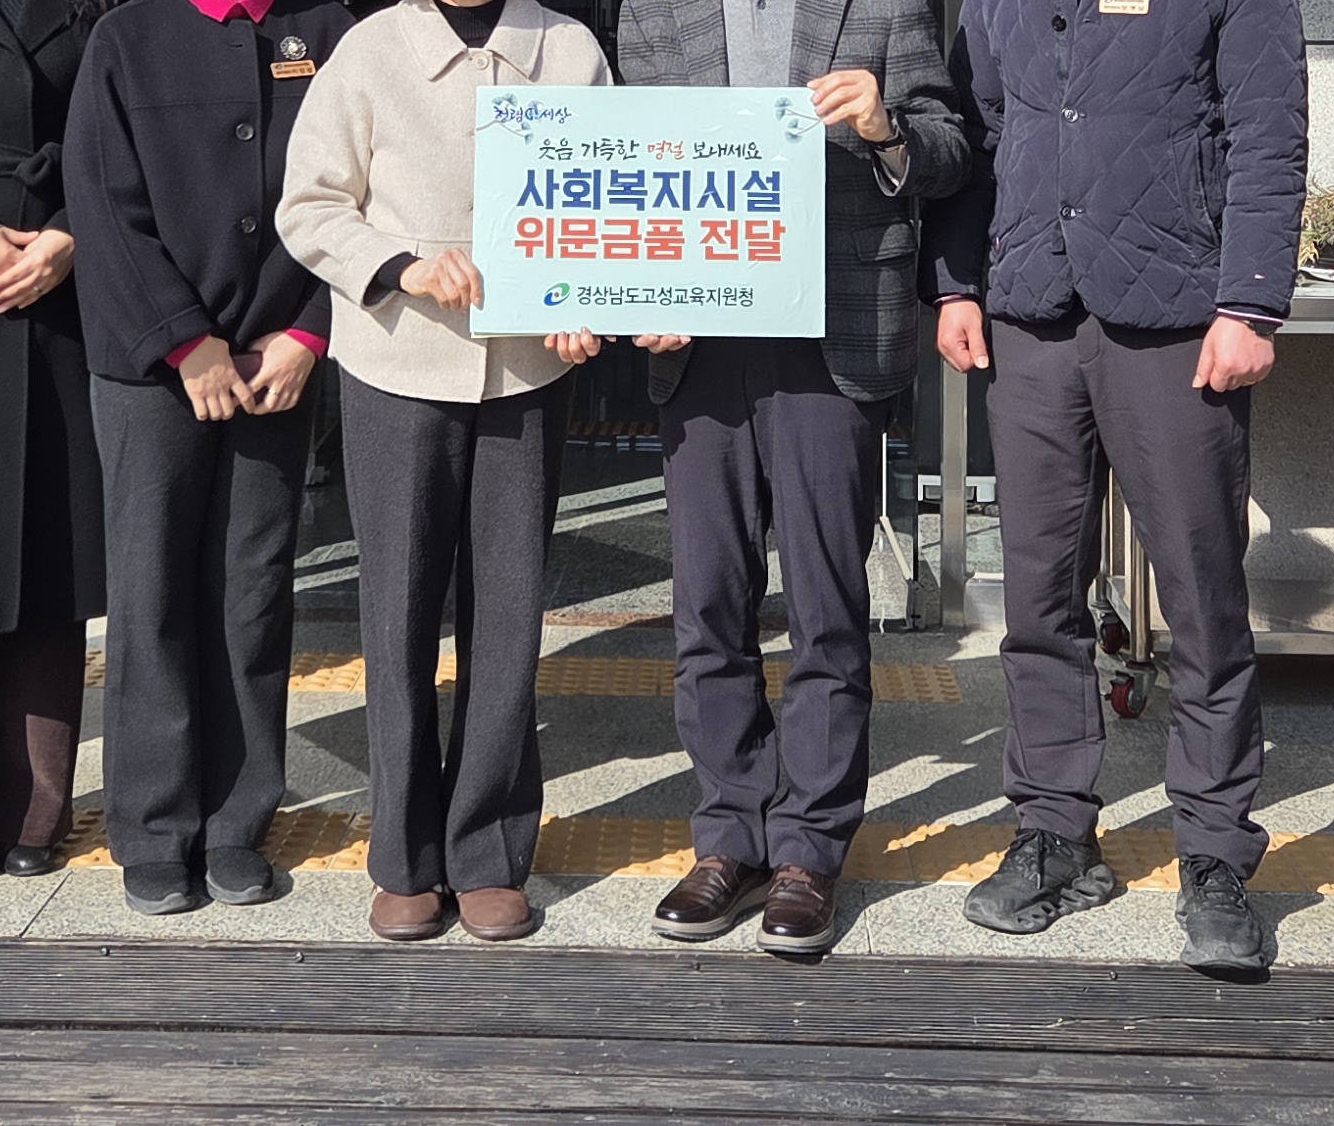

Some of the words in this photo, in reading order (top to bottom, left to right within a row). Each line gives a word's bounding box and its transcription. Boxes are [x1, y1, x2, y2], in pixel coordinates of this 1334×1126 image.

[538, 138, 574, 161] 웃음
[581, 138, 640, 161] 가득한
[647, 139, 685, 161] 명절
[692, 141, 763, 160] 보내세요
[516, 168, 782, 212] 사회복지시설
[514, 216, 685, 261] 위문금품
[699, 218, 786, 262] 전달
[576, 285, 754, 308] 경상남도고성교육지원청
